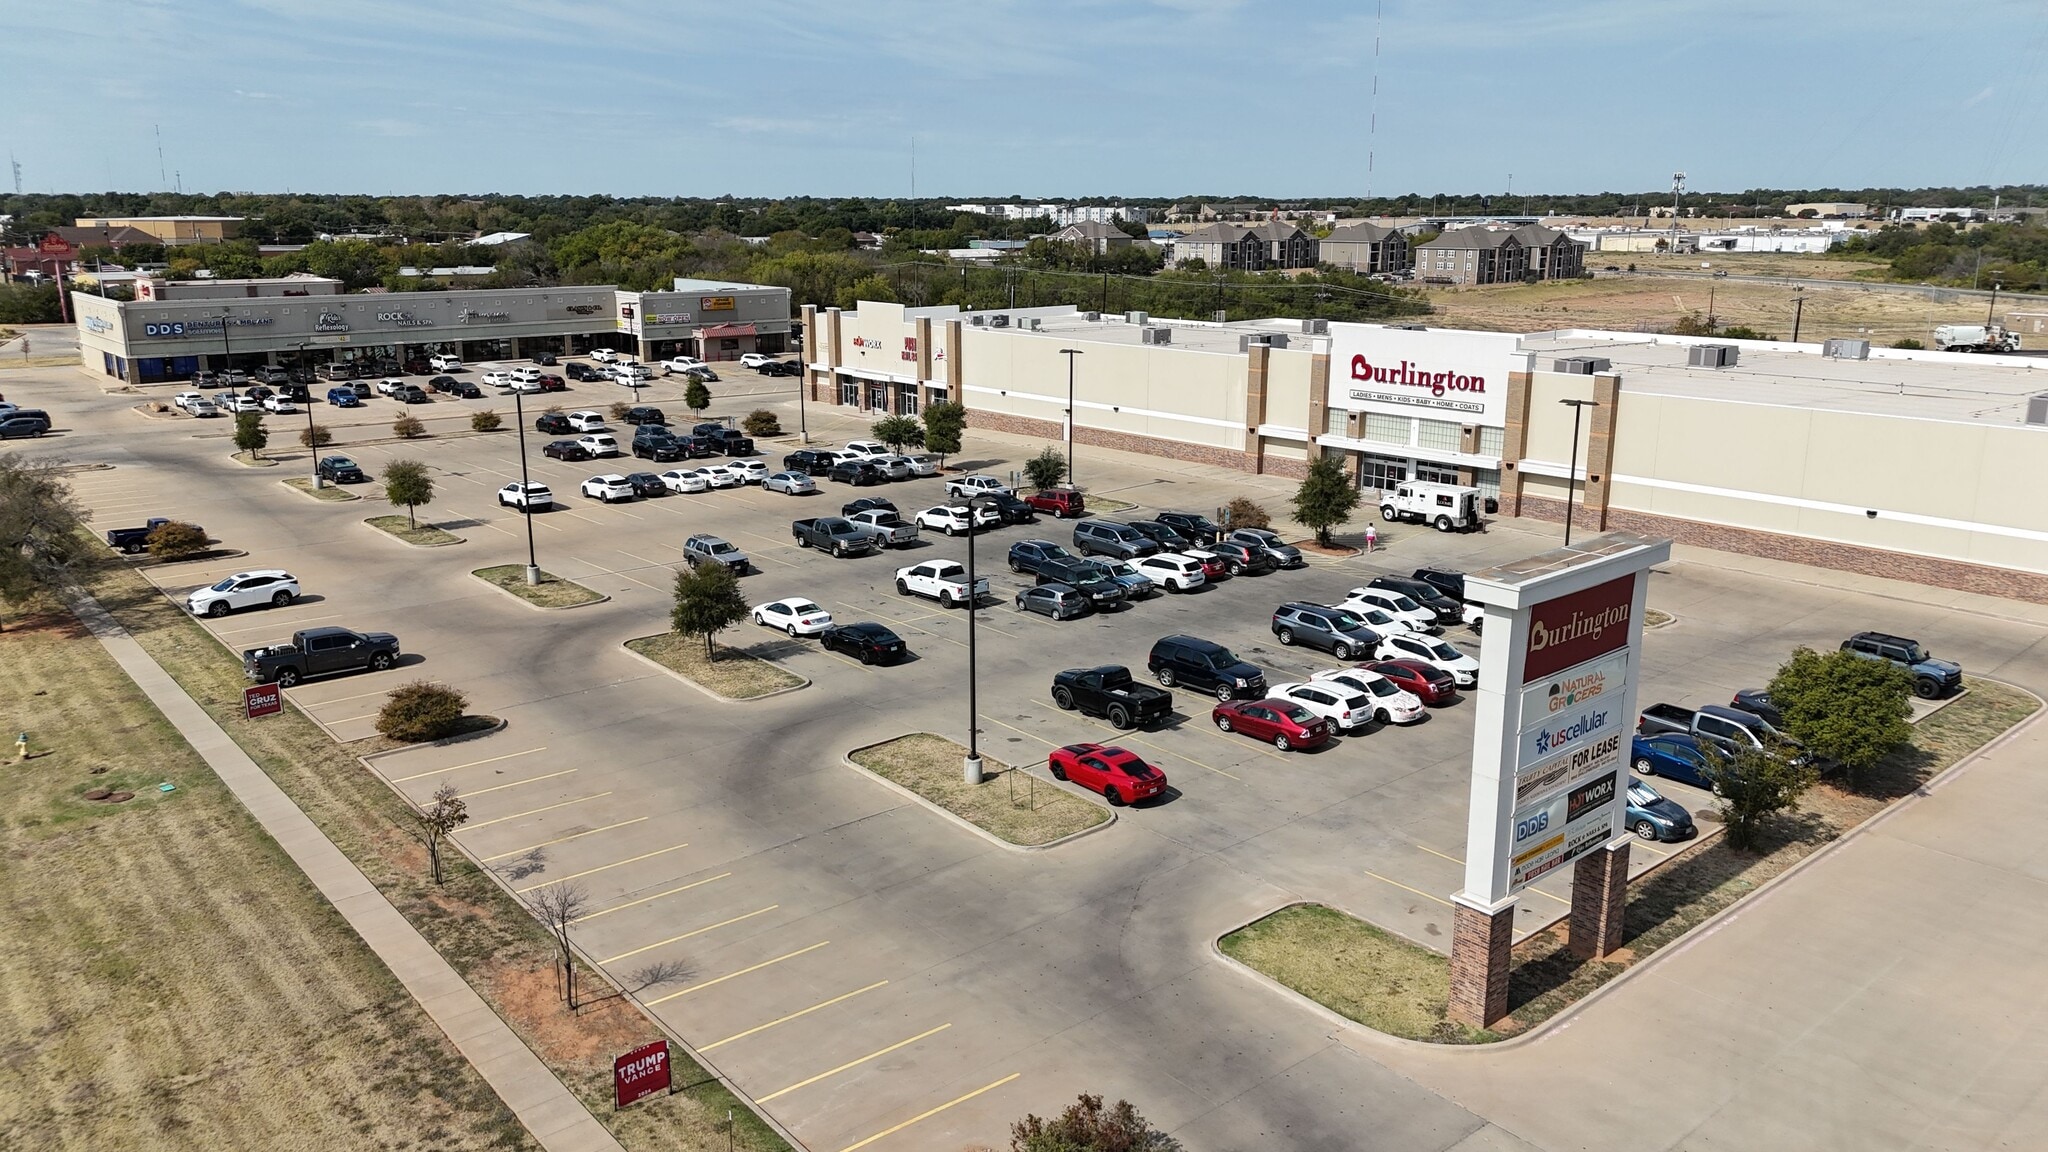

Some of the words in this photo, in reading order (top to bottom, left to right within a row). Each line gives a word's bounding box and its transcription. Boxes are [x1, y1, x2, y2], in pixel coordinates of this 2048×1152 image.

[314, 323, 348, 332] Reflexology
[377, 312, 403, 321] ROCK
[147, 323, 183, 336] DDS
[1351, 354, 1486, 397] Burlington
[1436, 400, 1454, 408] HOME
[1459, 403, 1480, 411] COATS
[1530, 603, 1629, 652] Burlington
[1561, 670, 1606, 694] NATURAL
[250, 694, 276, 705] CRUZ
[1548, 683, 1603, 712] GROCERS
[1571, 748, 1590, 770] FOR
[1590, 734, 1619, 761] LEASE
[1518, 813, 1547, 841] DDS
[1568, 835, 1582, 848] ROCK
[618, 1052, 665, 1079] TRUMP
[624, 1063, 661, 1084] VANCE
